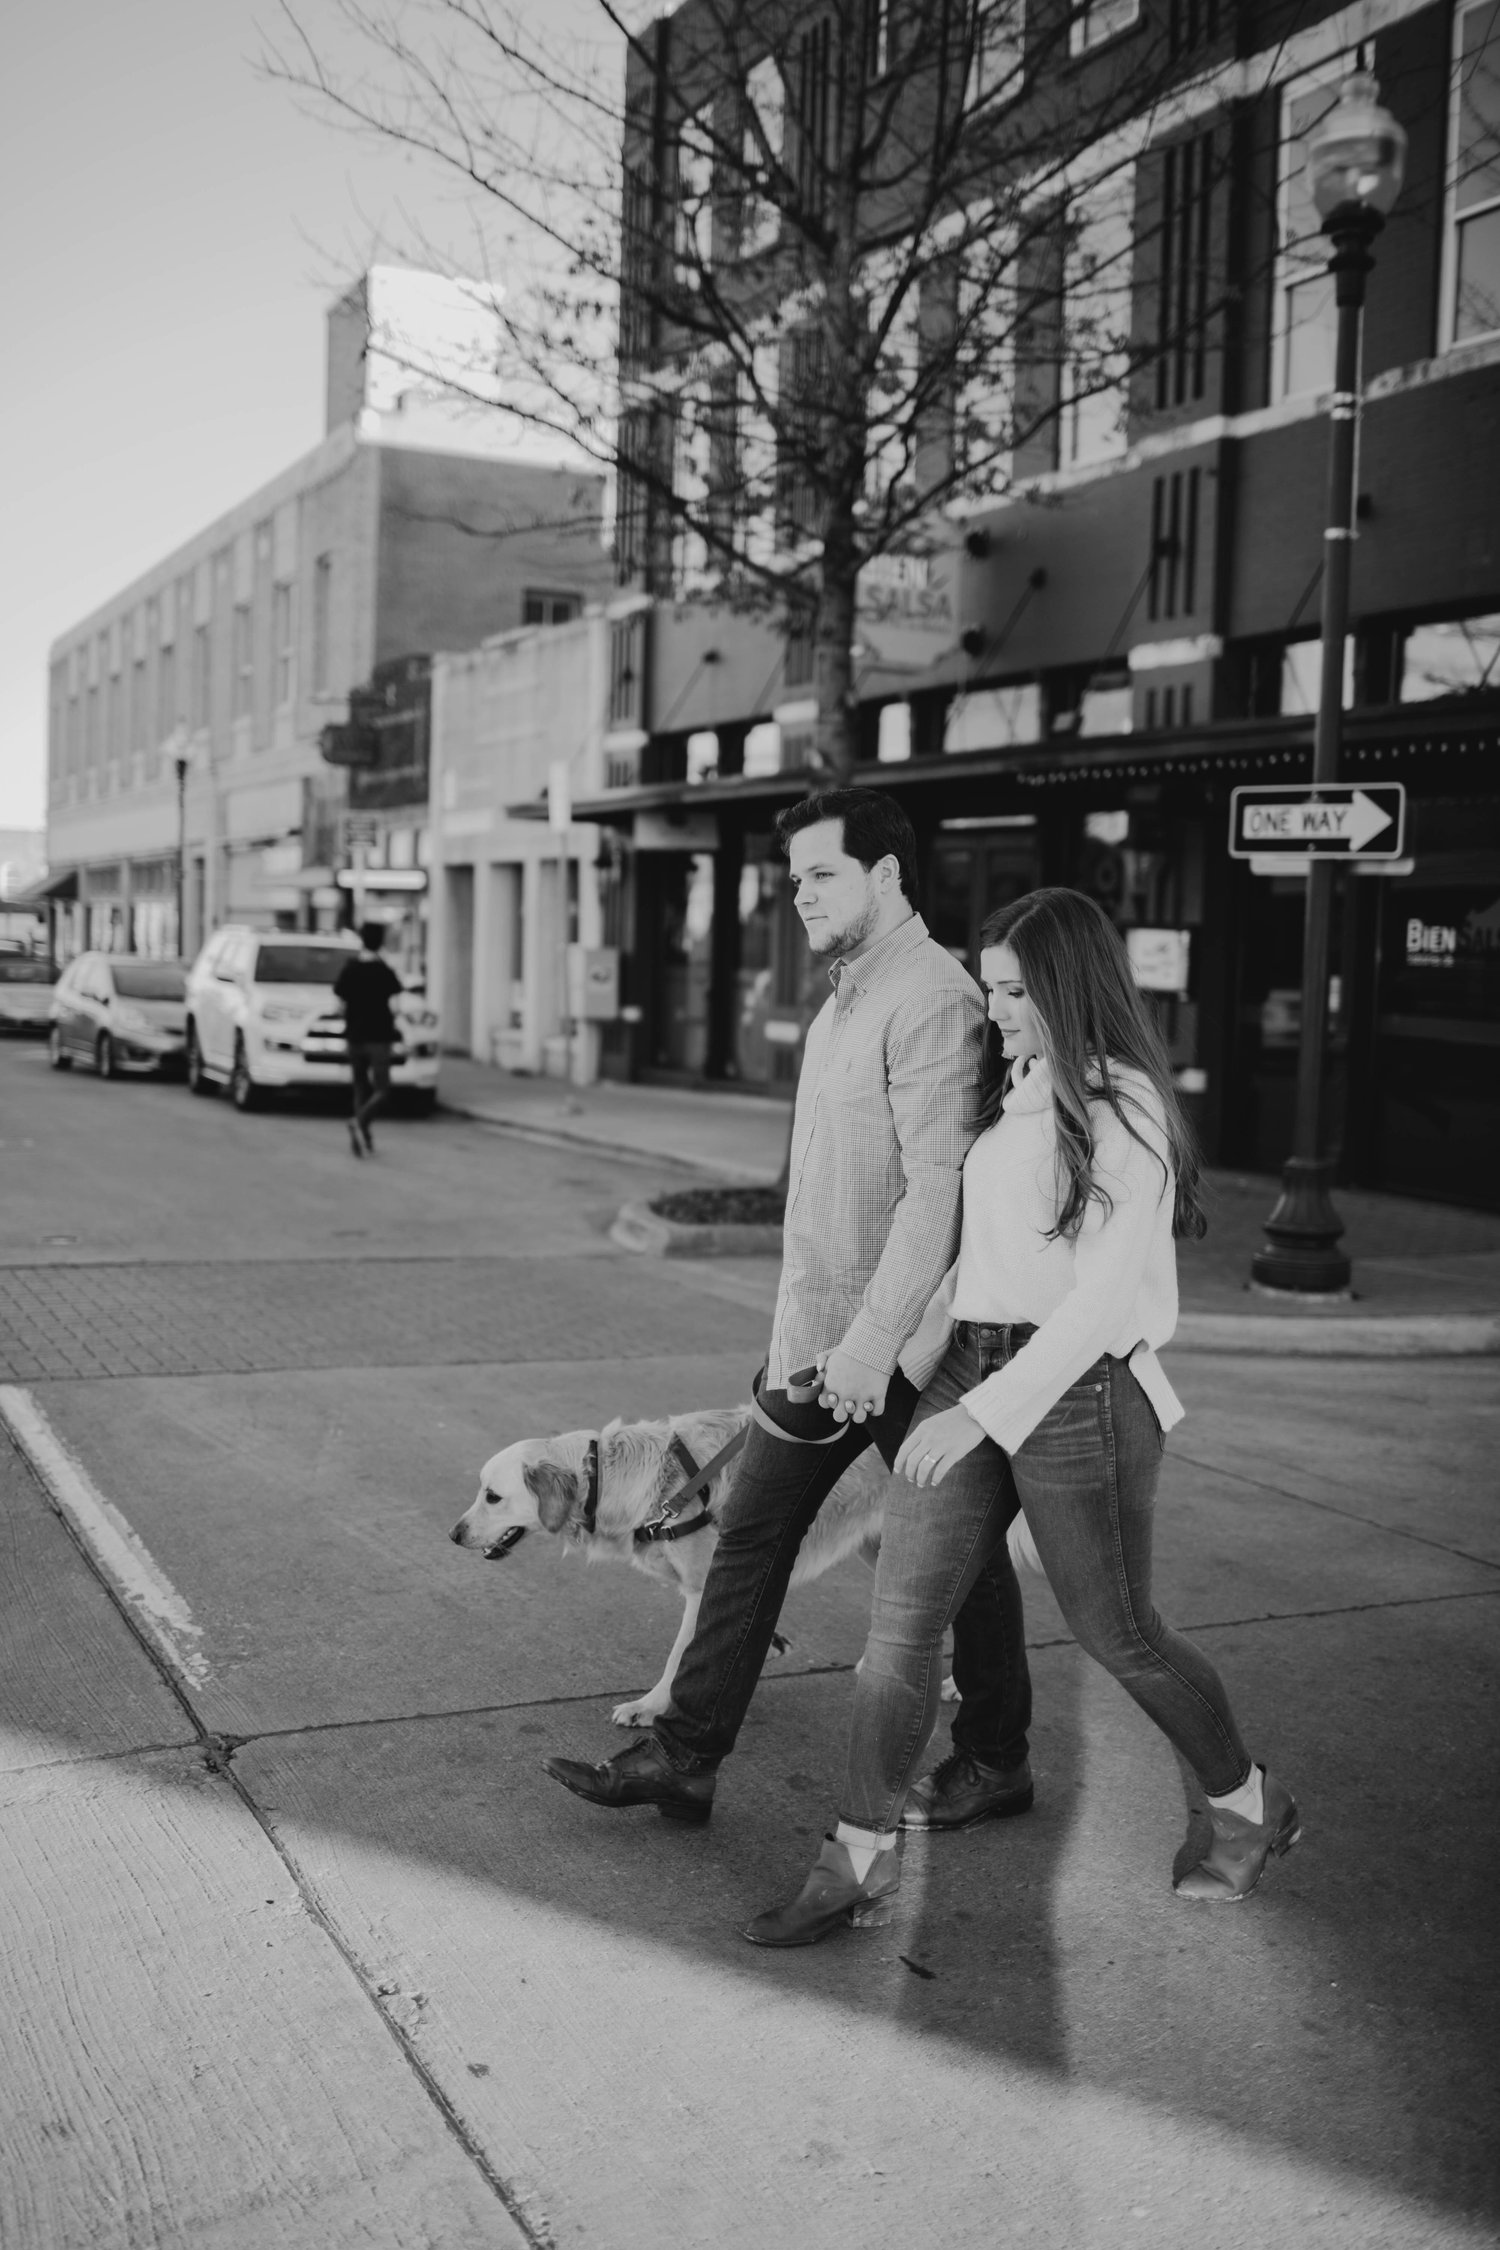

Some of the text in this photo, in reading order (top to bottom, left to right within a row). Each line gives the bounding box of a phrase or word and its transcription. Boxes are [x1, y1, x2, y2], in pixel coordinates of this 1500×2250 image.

[864, 584, 952, 621] SALSA
[1250, 809, 1347, 833] ONE WAY
